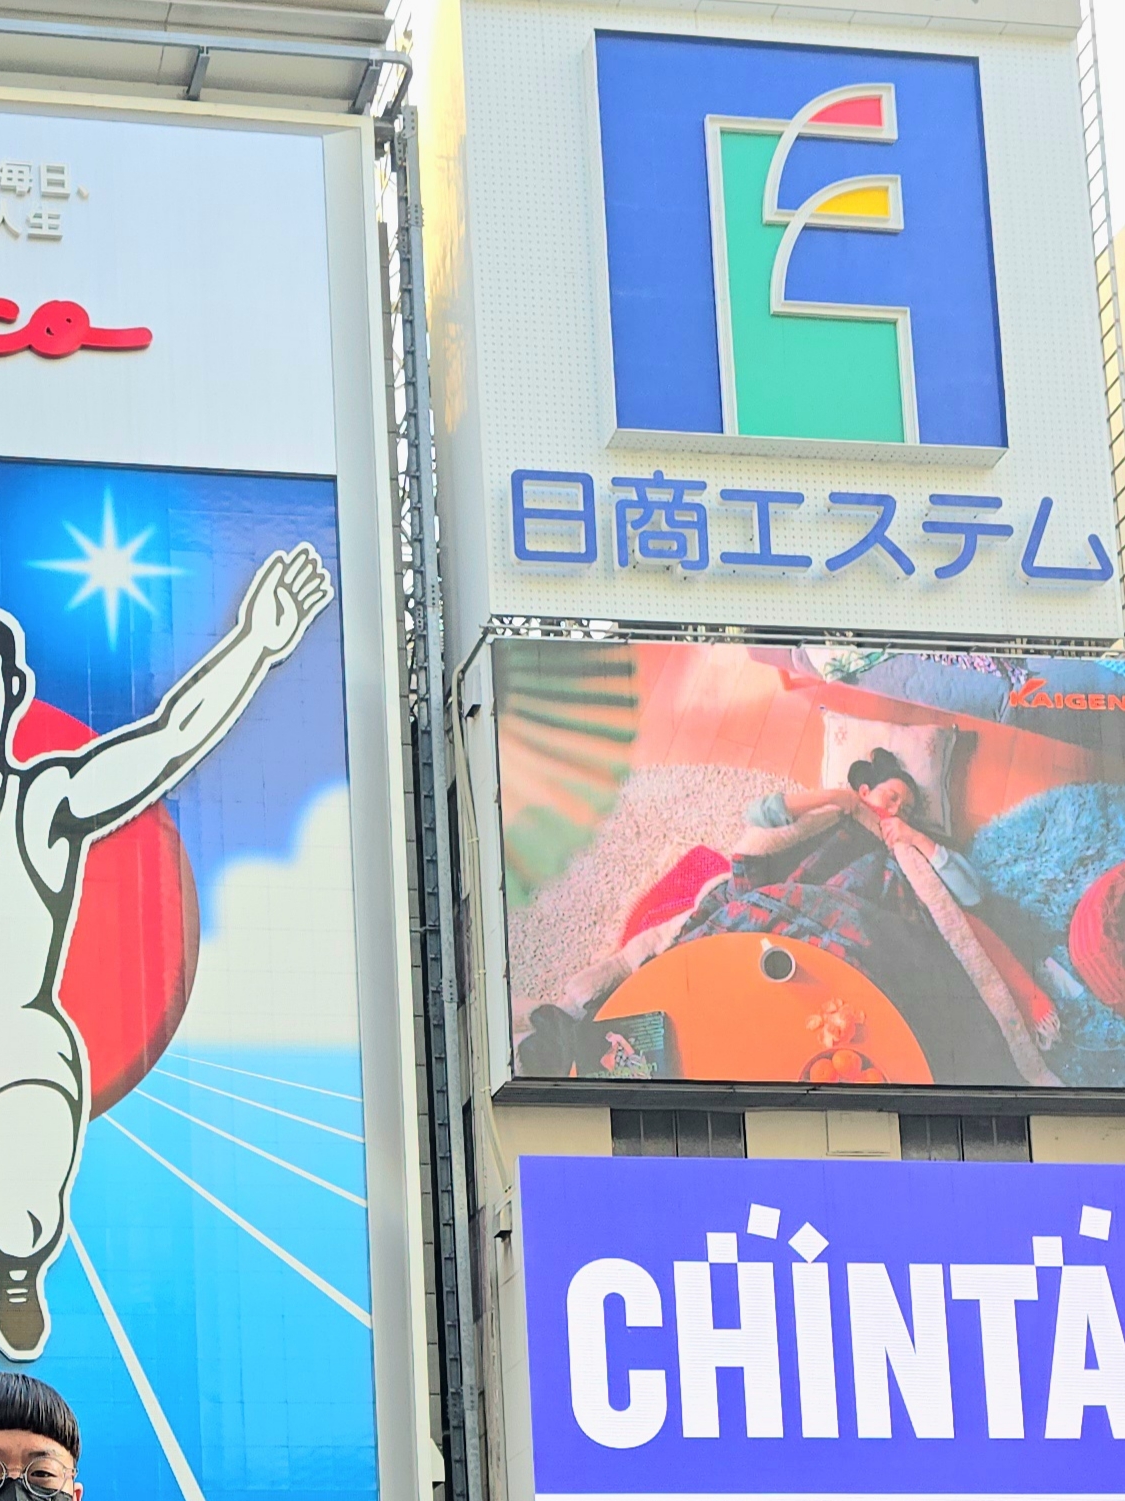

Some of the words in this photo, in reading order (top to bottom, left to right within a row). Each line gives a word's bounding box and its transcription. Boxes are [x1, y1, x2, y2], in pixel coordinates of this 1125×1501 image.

[510, 468, 1114, 582] 日商エステム
